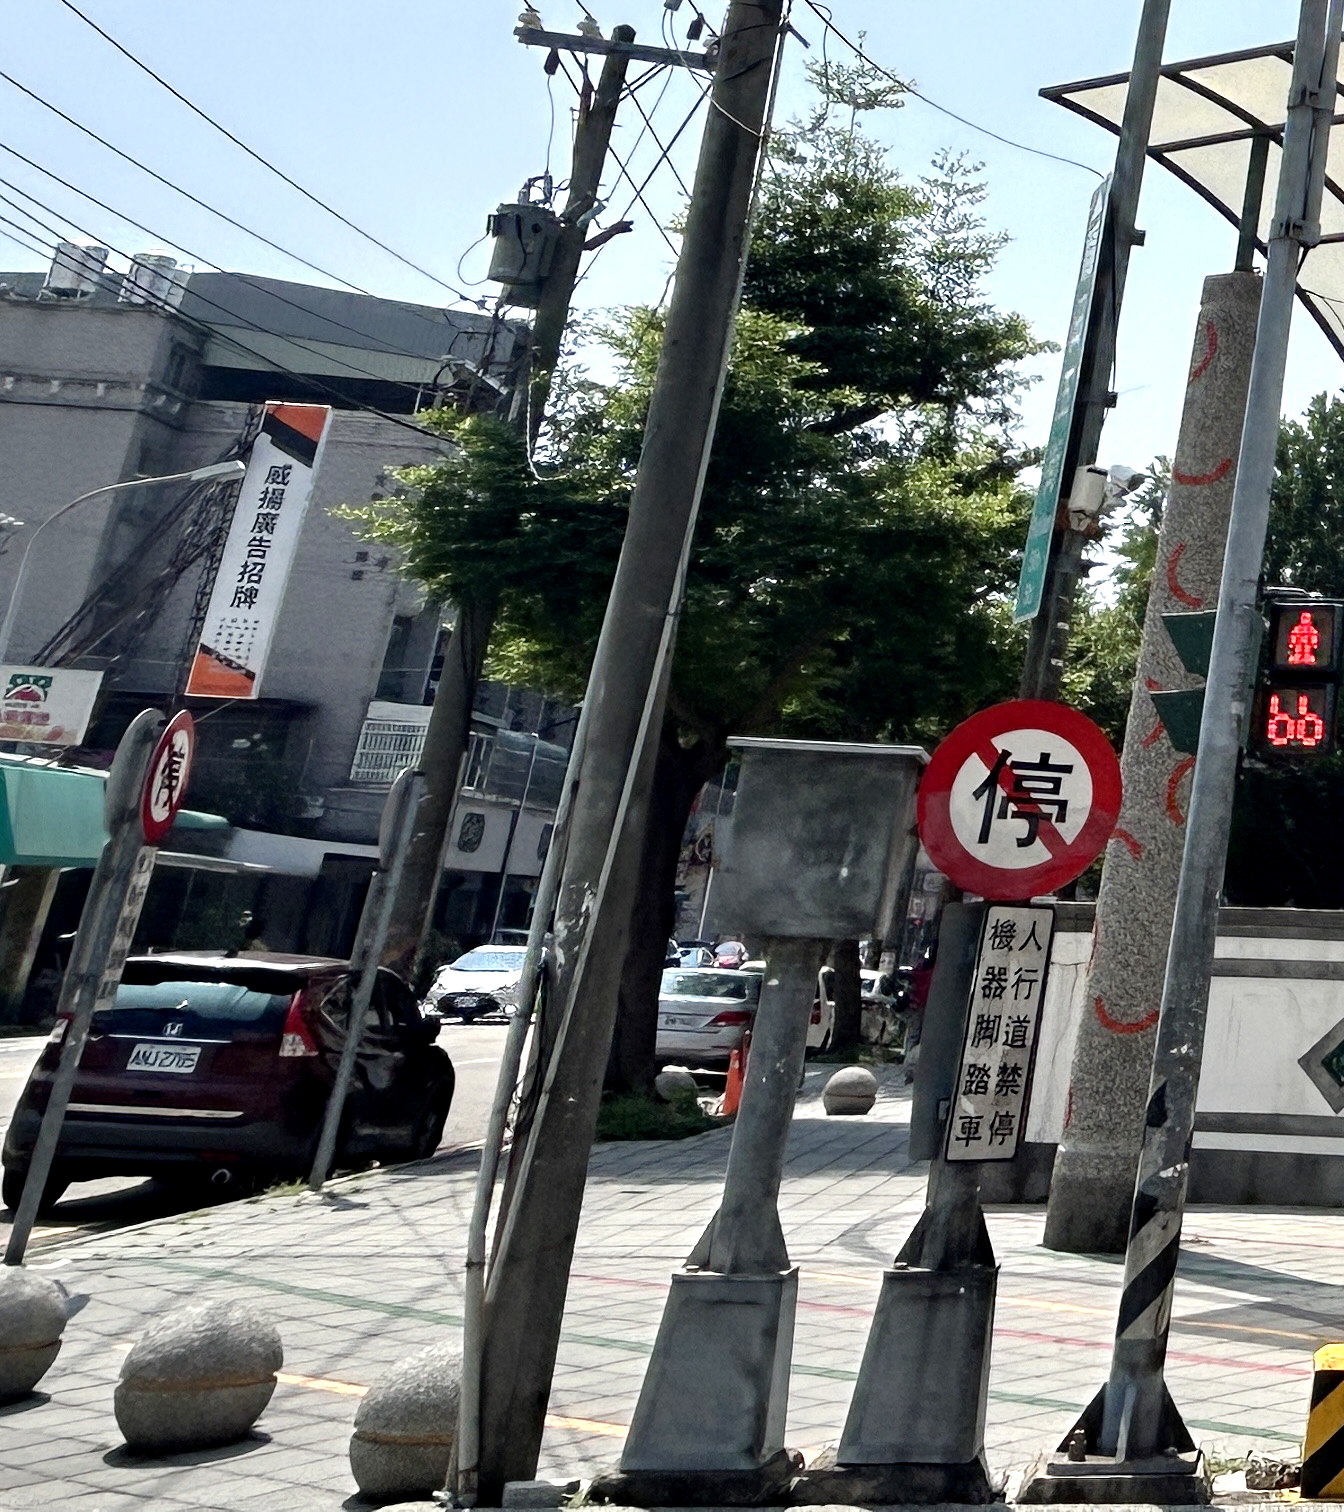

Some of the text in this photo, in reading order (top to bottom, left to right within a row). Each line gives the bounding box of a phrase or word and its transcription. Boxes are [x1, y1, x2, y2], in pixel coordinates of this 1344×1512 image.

[972, 748, 1074, 849] 停
[988, 919, 1043, 1146] 人行道禁停
